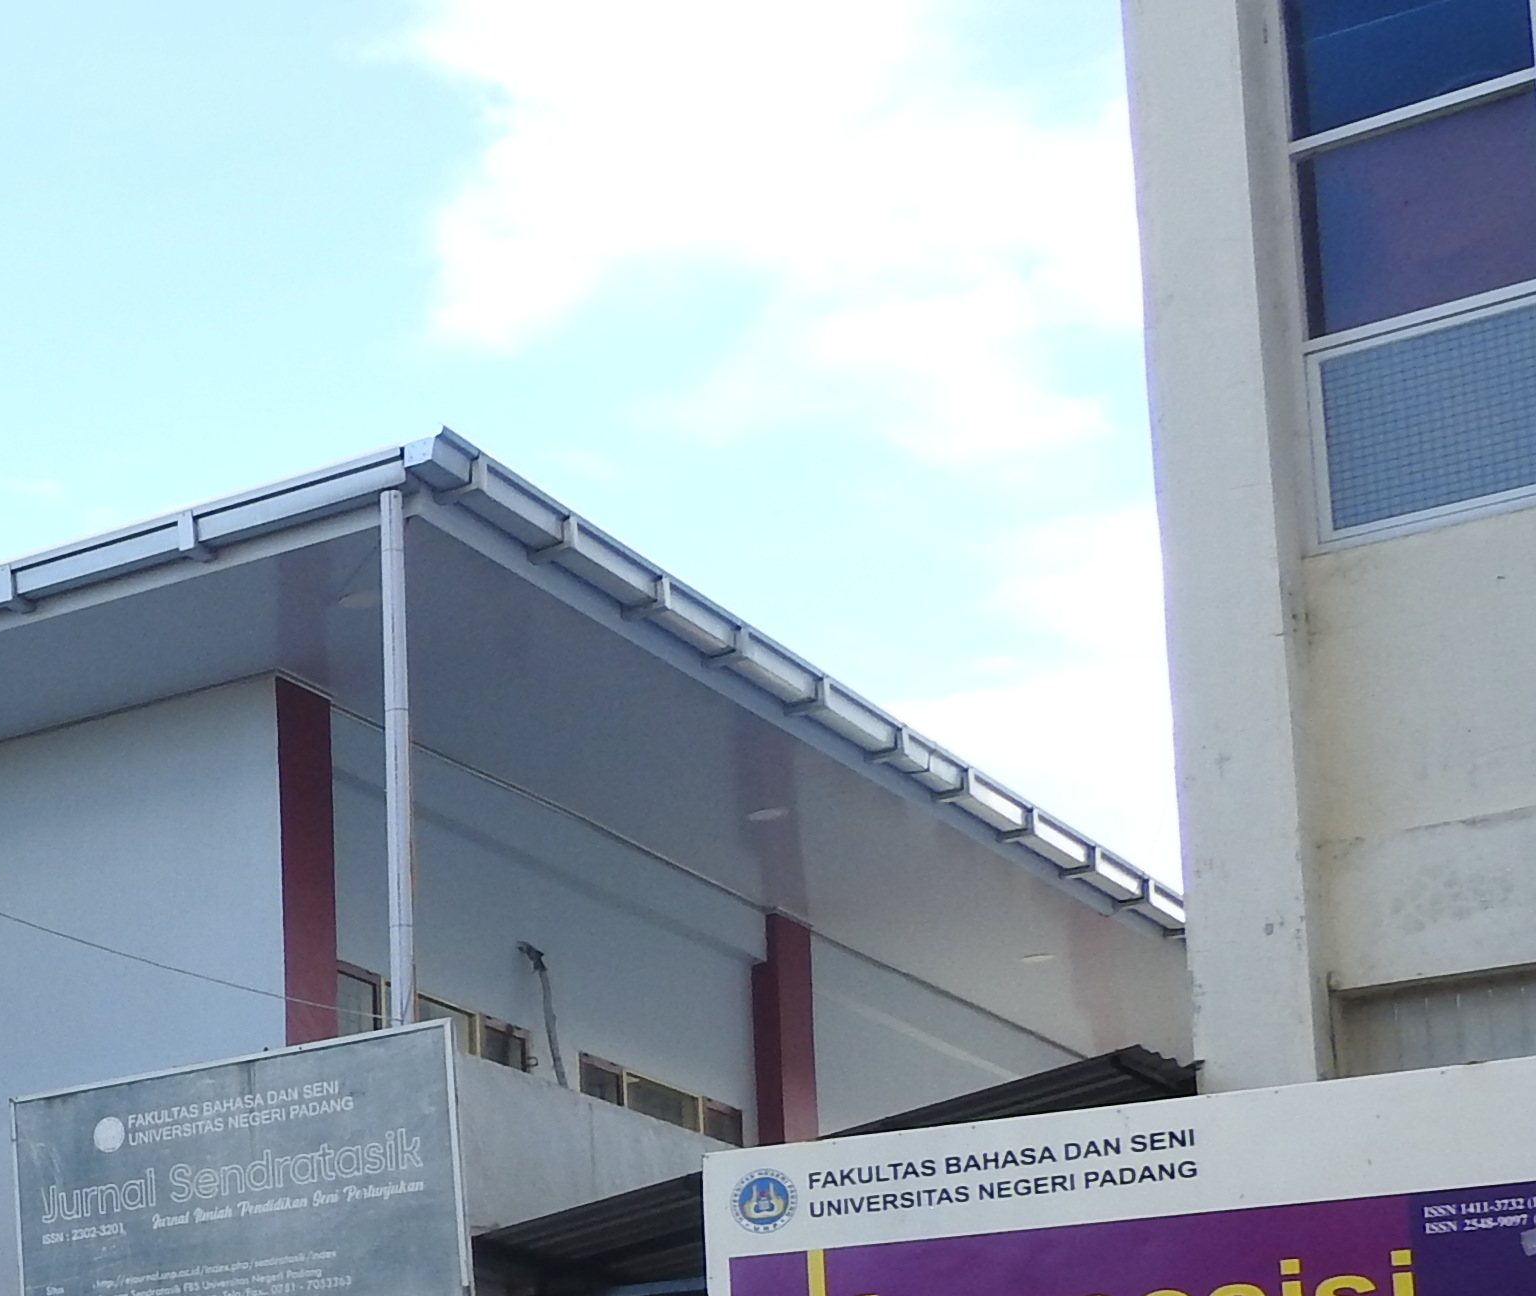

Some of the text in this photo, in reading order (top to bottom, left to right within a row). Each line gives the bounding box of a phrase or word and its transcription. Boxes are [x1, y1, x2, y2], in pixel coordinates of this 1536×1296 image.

[128, 1081, 338, 1128] FAKULTAS BAHASA DAN SENI
[129, 1096, 354, 1146] UNIVERSITAS NEGERI PADANG
[42, 1128, 424, 1224] Jurnal Sendratasik
[808, 1128, 1195, 1190] FAKULTAS BAHASA DAN SENI
[152, 1180, 424, 1230] Jurnal Ilmiah Pendidikan Seni Pertunjukan
[809, 1160, 1198, 1218] UNIVERSITAS NEGERI PADANG
[1424, 1204, 1456, 1218] ISSN
[42, 1232, 64, 1245] ISSN
[1425, 1221, 1458, 1234] ISSN
